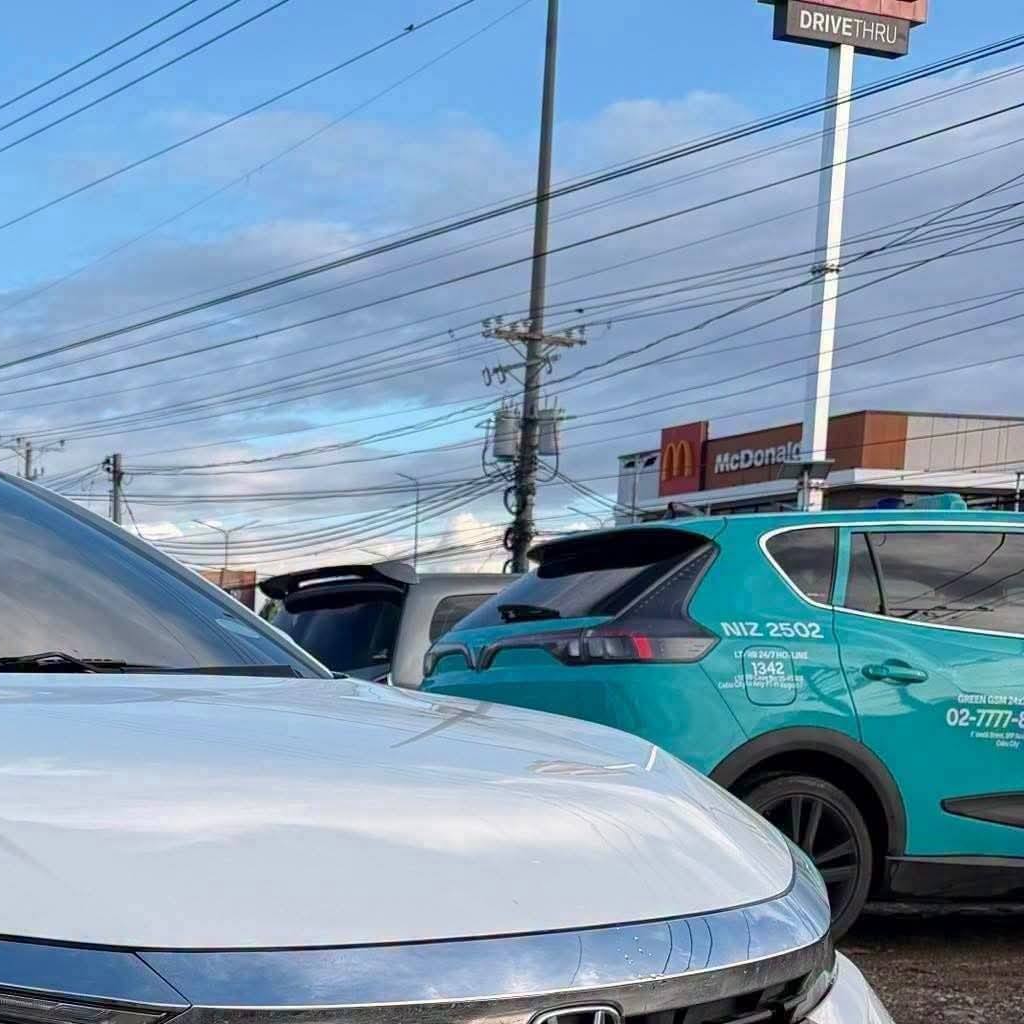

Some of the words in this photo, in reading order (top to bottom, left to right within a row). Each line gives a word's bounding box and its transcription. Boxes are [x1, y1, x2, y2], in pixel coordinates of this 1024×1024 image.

[720, 622, 764, 637] NIZ
[766, 622, 824, 639] 2502
[751, 661, 785, 676] 1342
